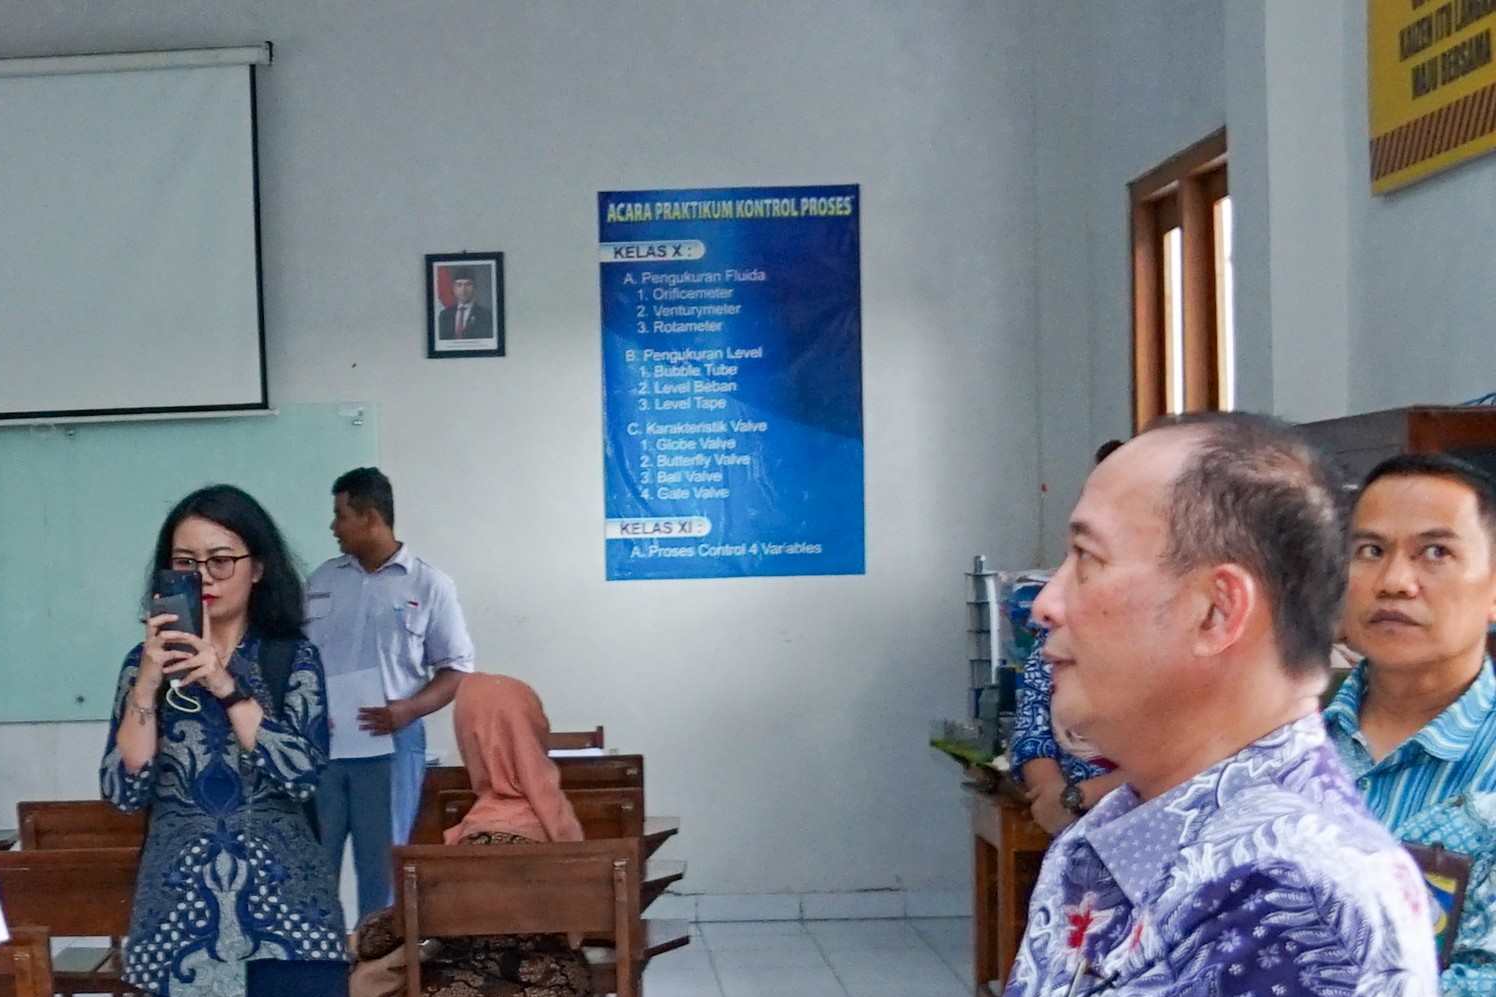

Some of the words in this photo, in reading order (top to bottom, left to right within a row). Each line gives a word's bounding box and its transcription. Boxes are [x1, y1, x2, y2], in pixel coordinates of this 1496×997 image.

[607, 202, 652, 223] ACARA
[655, 200, 733, 220] PRAKTIKUM
[736, 198, 797, 218] KONTROL
[800, 196, 852, 216] PROSES
[613, 245, 666, 259] KELAS
[672, 244, 682, 257] X
[623, 272, 636, 284] A.
[641, 270, 721, 286] Pengukuran
[725, 269, 766, 282] Fluida
[637, 289, 649, 301] 1.
[637, 322, 649, 334] 3.
[654, 320, 723, 333] Rotameter
[643, 348, 723, 364] Pengukuran
[726, 347, 763, 359] Level
[705, 364, 738, 376] Tube
[654, 381, 690, 394] Level
[694, 380, 737, 393] Beban
[638, 399, 650, 410] 3.
[654, 398, 690, 410] Level
[693, 397, 727, 411] Tape
[627, 423, 642, 435] C.
[730, 420, 768, 432] Valve
[699, 437, 737, 449] Valve
[714, 453, 751, 465] Valve
[685, 470, 723, 483] Valve
[692, 486, 729, 498] Valve
[620, 521, 673, 535] KELAS
[678, 520, 693, 533] XI
[647, 544, 695, 558] Proses
[698, 543, 747, 558] Control
[760, 542, 823, 556] Variables
